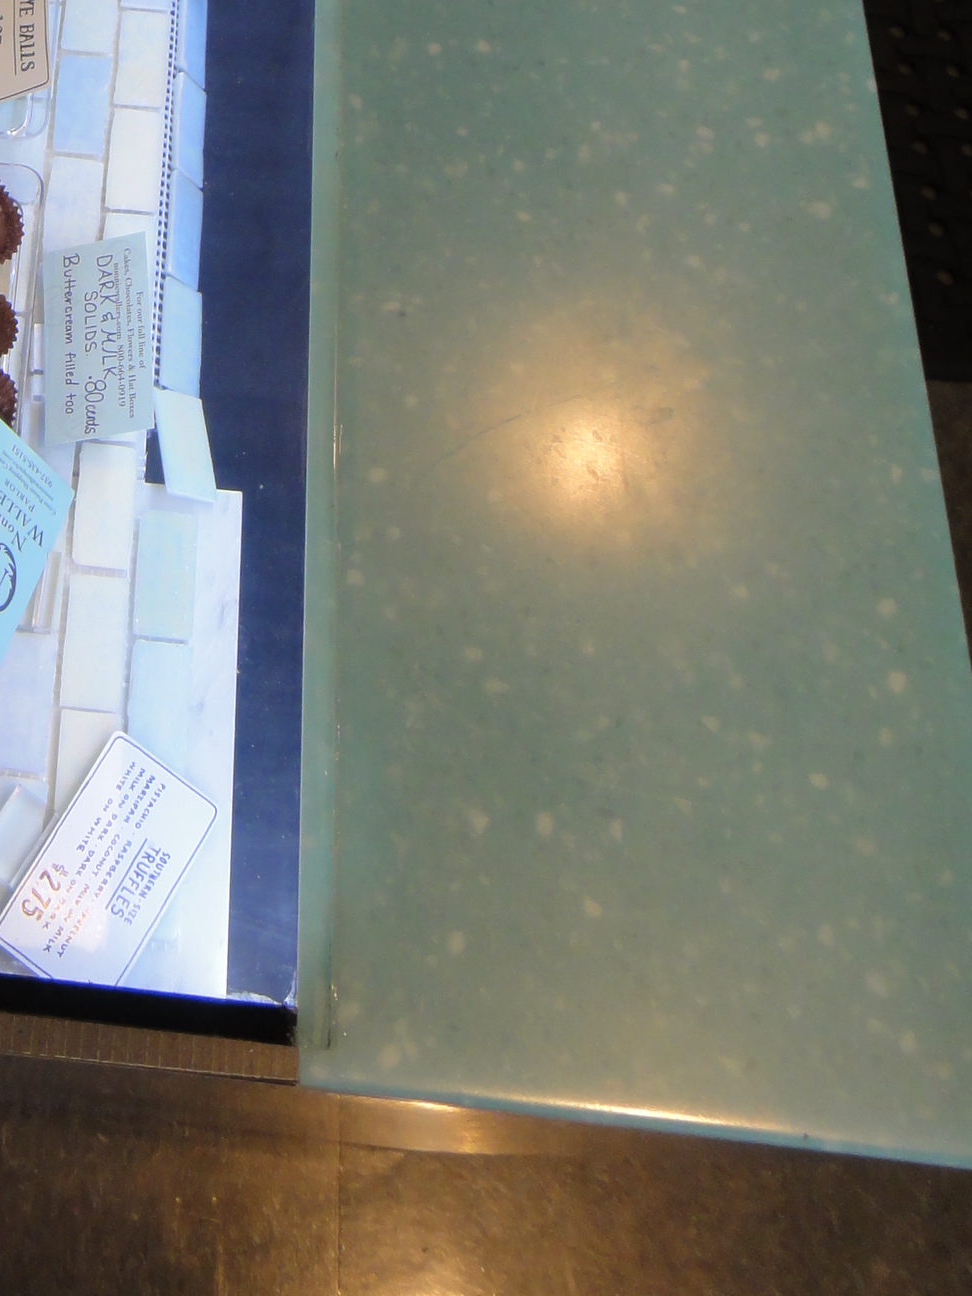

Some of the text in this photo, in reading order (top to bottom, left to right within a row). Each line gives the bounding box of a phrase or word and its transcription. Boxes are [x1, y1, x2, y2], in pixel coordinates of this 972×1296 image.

[18, 23, 35, 71] BALLS
[123, 248, 131, 275] Cakes,
[96, 254, 118, 379] DARK & MILK
[124, 277, 133, 325] Chocolates,
[62, 253, 80, 414] Buttercream filled too
[113, 262, 125, 406] nonniewallers.com 800-664-0919
[128, 374, 136, 390] Hat
[138, 360, 146, 368] of
[128, 392, 136, 418] Boxes
[8, 465, 28, 489] Shopping
[11, 444, 52, 487] 937-435-5151
[4, 478, 35, 512] PARLOR
[128, 767, 145, 791] MILK
[75, 761, 135, 852] WHITE ON WHITE
[118, 793, 129, 808] ON
[123, 774, 155, 823] MARZIPAN
[134, 782, 166, 829] PISTACHIO
[96, 813, 117, 841] DARK
[75, 849, 95, 876] DARK
[91, 833, 120, 877] COCONUT
[94, 839, 132, 898] RASPBERRY
[21, 862, 68, 921] $2.75
[65, 878, 76, 893] ON
[74, 883, 89, 905] MILK
[110, 847, 161, 918] TRUFFLES
[42, 927, 63, 953] MILK
